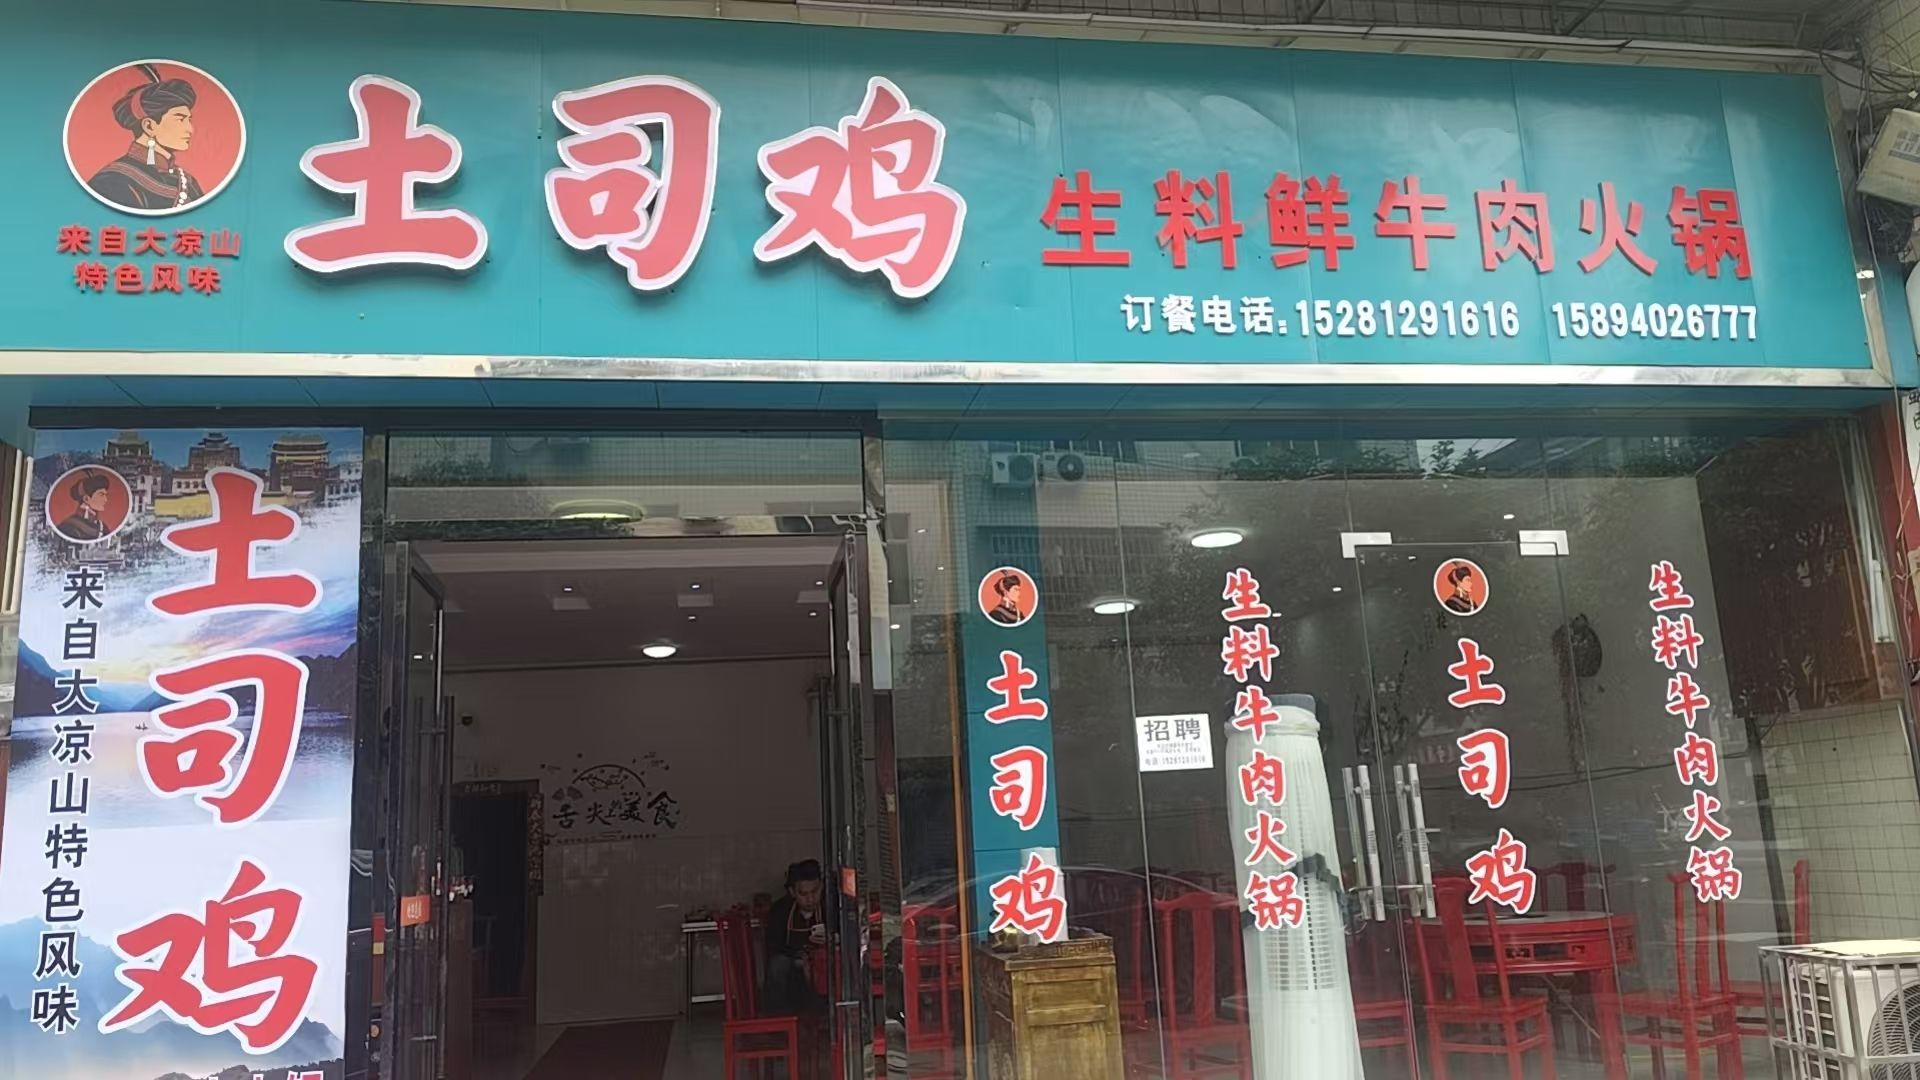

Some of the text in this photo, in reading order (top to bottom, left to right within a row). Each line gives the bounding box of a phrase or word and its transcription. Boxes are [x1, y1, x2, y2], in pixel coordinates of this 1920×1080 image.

[58, 226, 241, 256] 来自大凉山
[74, 263, 221, 294] 特色风味
[284, 75, 967, 298] 土司鸡
[1041, 170, 1752, 279] 生料鲜牛肉火锅
[1552, 302, 1758, 340] 15894026777
[32, 566, 105, 1033] 来自大凉山特色风味
[98, 466, 323, 1054] 土司鸡
[985, 650, 1068, 943] 土司鸡
[1143, 717, 1201, 742] 招聘
[1221, 567, 1306, 930] 生料牛肉火锅
[1448, 637, 1537, 915] 土司鸡
[1650, 560, 1742, 903] 生料牛肉火锅
